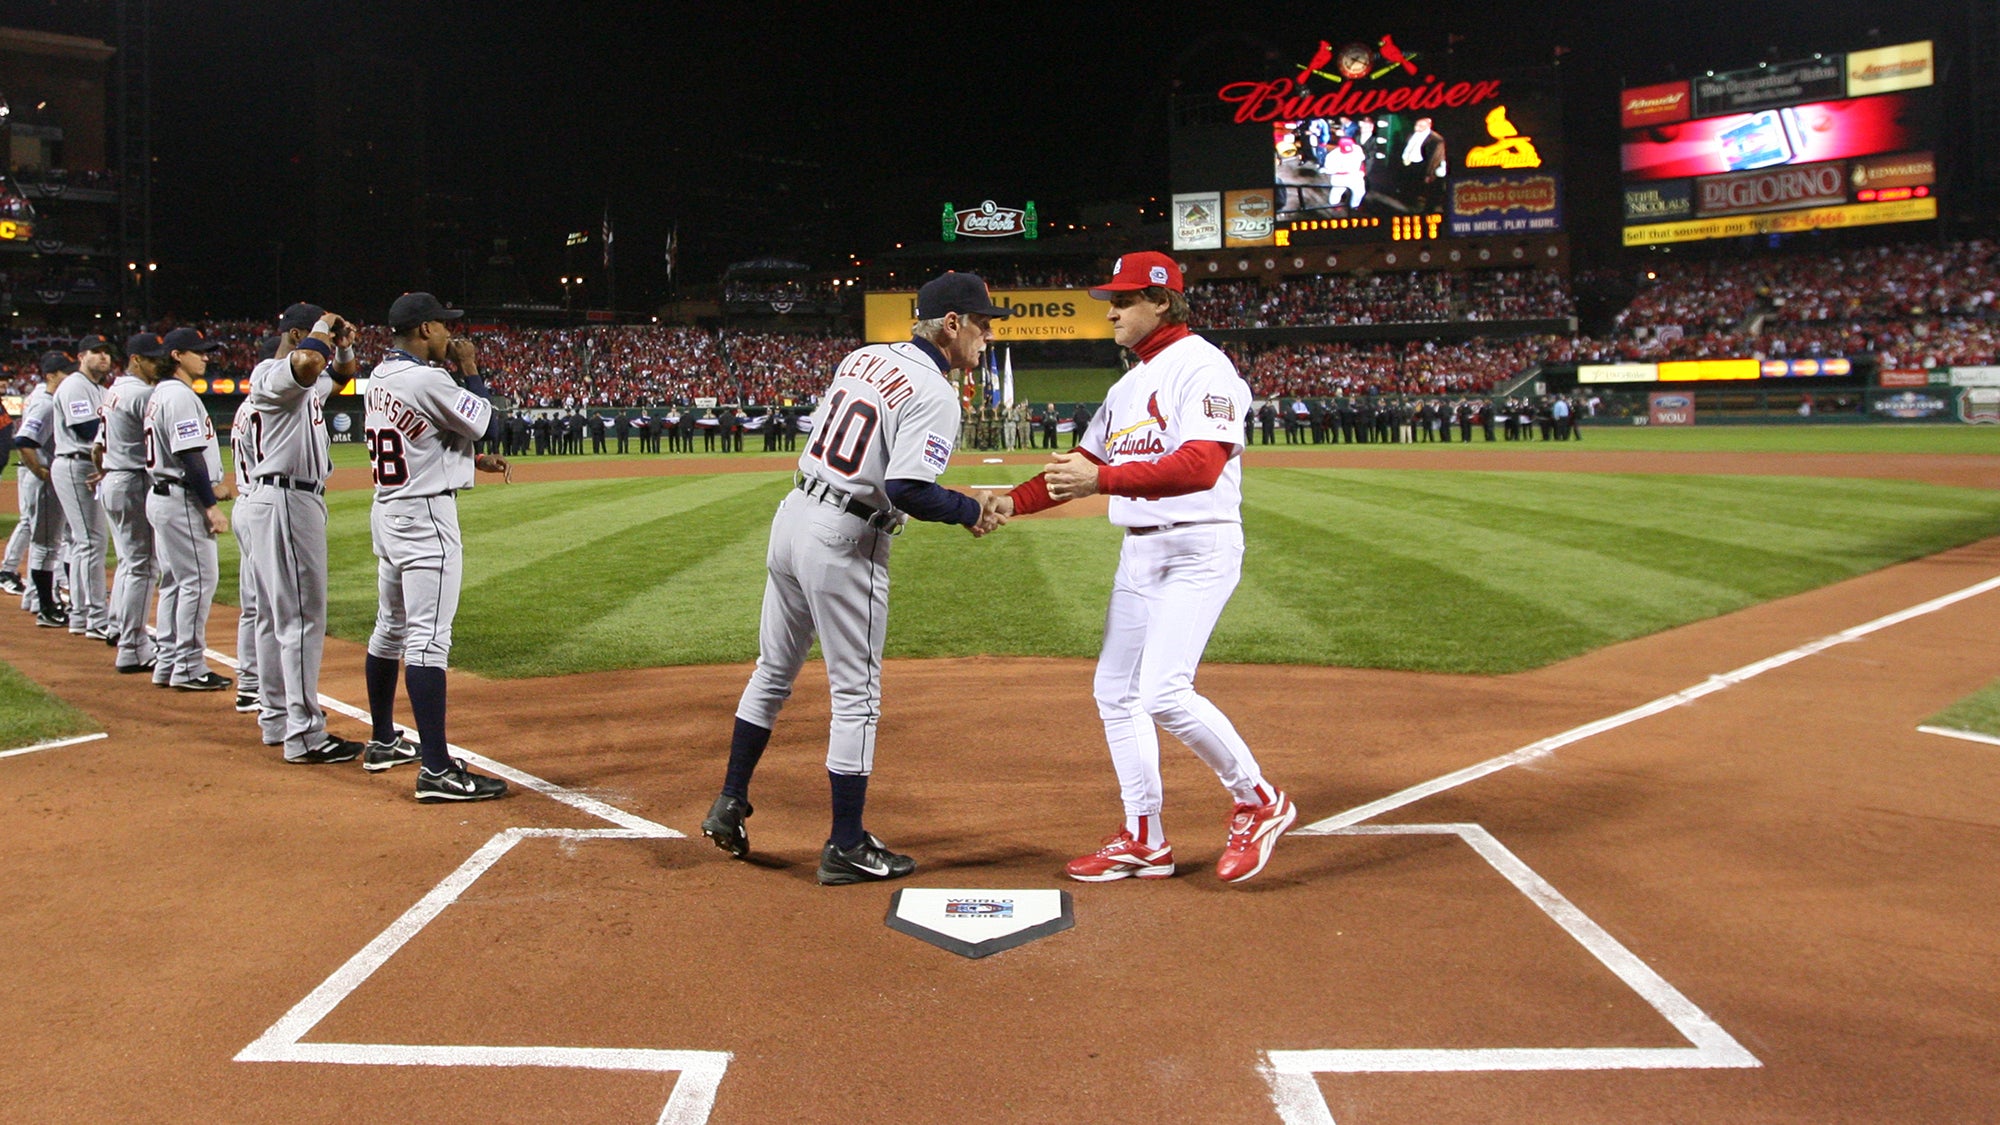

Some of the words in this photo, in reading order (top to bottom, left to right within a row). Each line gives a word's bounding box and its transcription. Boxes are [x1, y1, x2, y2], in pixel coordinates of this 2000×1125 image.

[1218, 75, 1500, 124] Budweiser
[1454, 223, 1471, 232] WIN
[1504, 219, 1527, 230] PLAY
[999, 327, 1012, 336] OF
[1016, 326, 1075, 336] INVESTING
[838, 353, 914, 410] LEYLAND
[366, 387, 428, 441] NDERSON
[809, 389, 879, 477] 10
[1657, 413, 1687, 423] YOU
